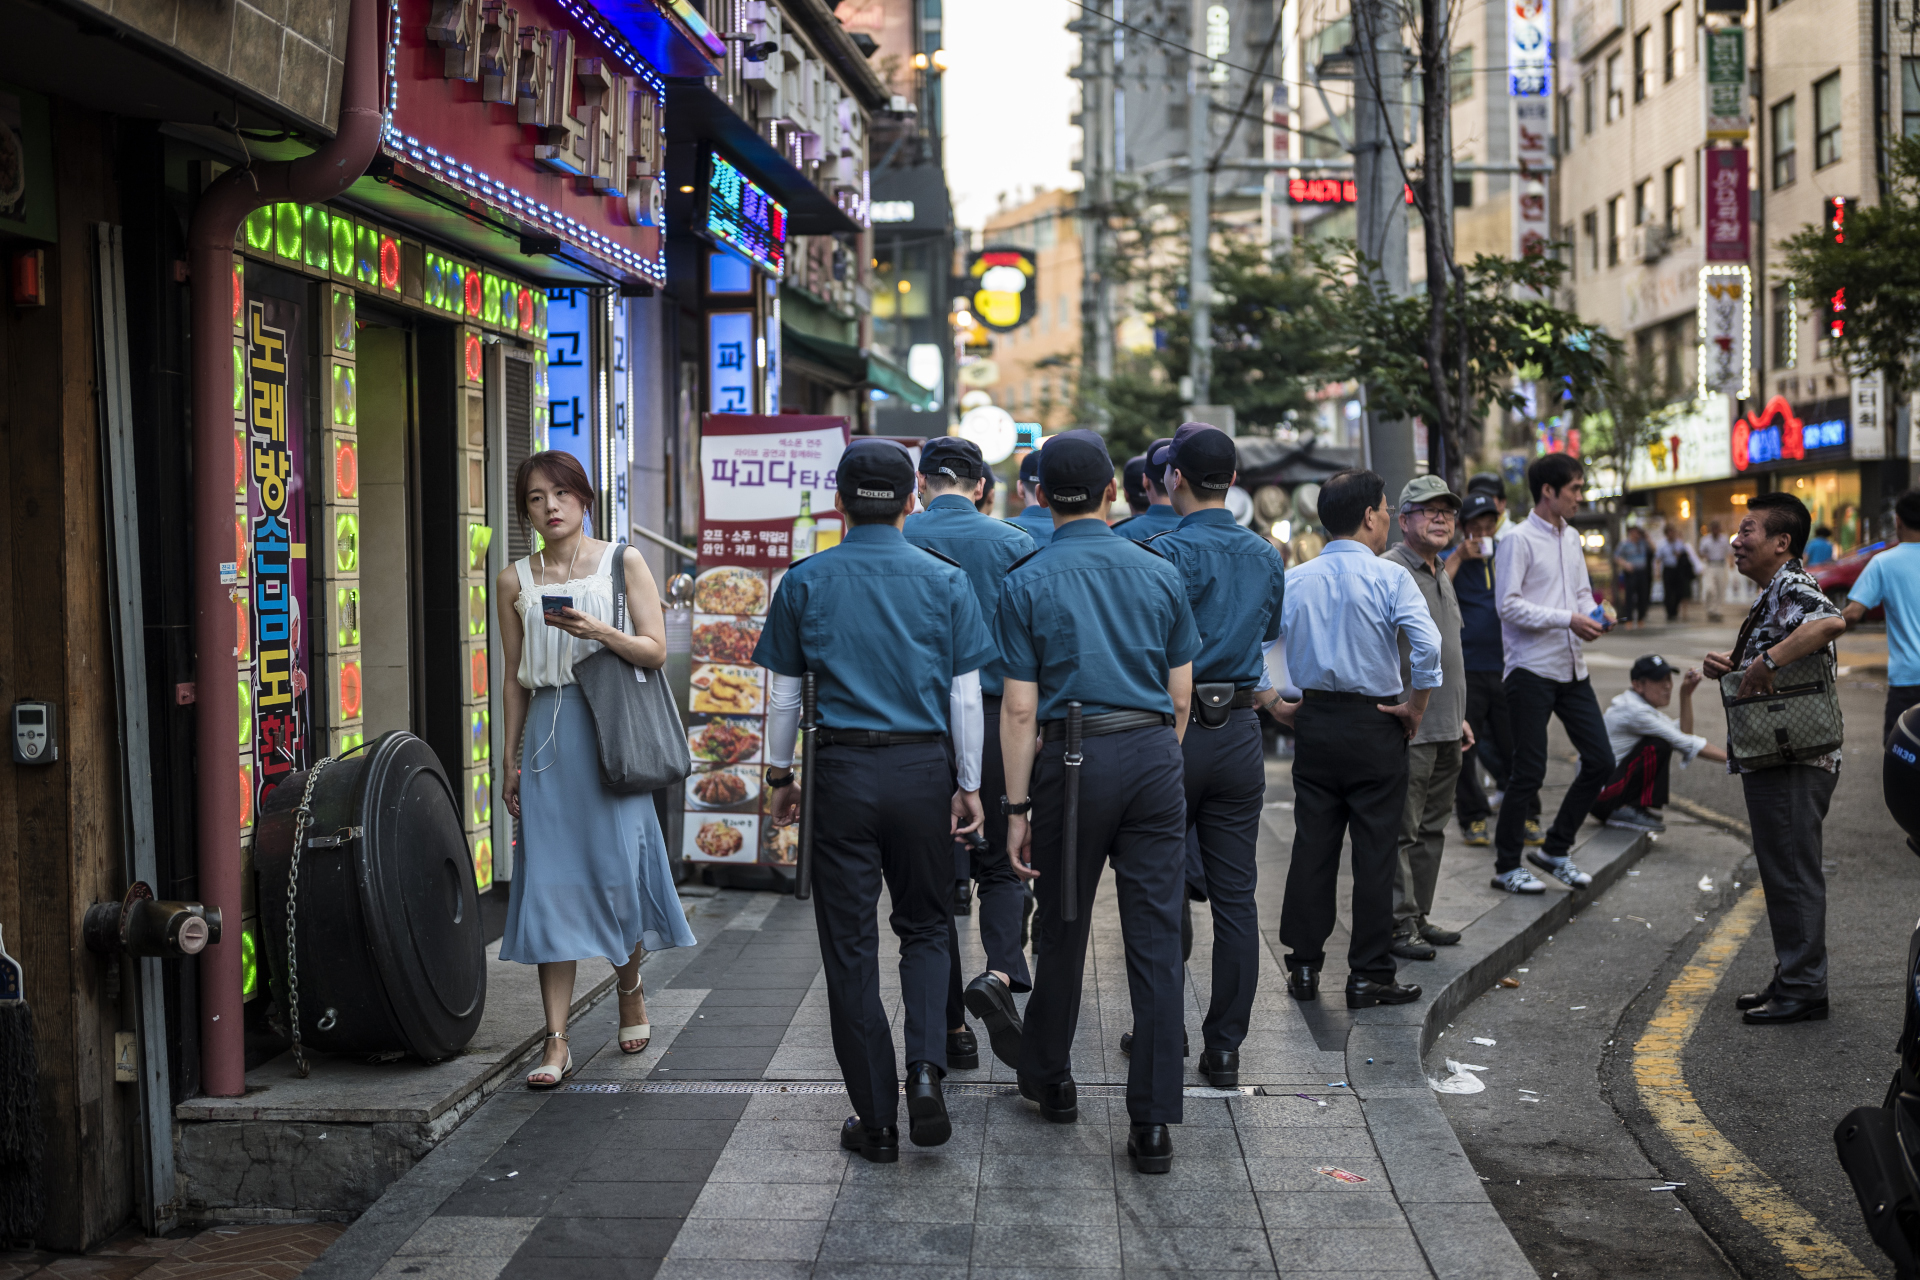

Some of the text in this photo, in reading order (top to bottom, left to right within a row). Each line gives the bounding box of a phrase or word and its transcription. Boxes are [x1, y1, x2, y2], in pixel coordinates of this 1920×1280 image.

[252, 312, 290, 511] 노래방
[860, 490, 892, 498] POLICE
[703, 529, 724, 542] 호프
[731, 530, 752, 543] 소주
[759, 530, 789, 544] 막걸리
[702, 543, 789, 558] 와인 커피 음료
